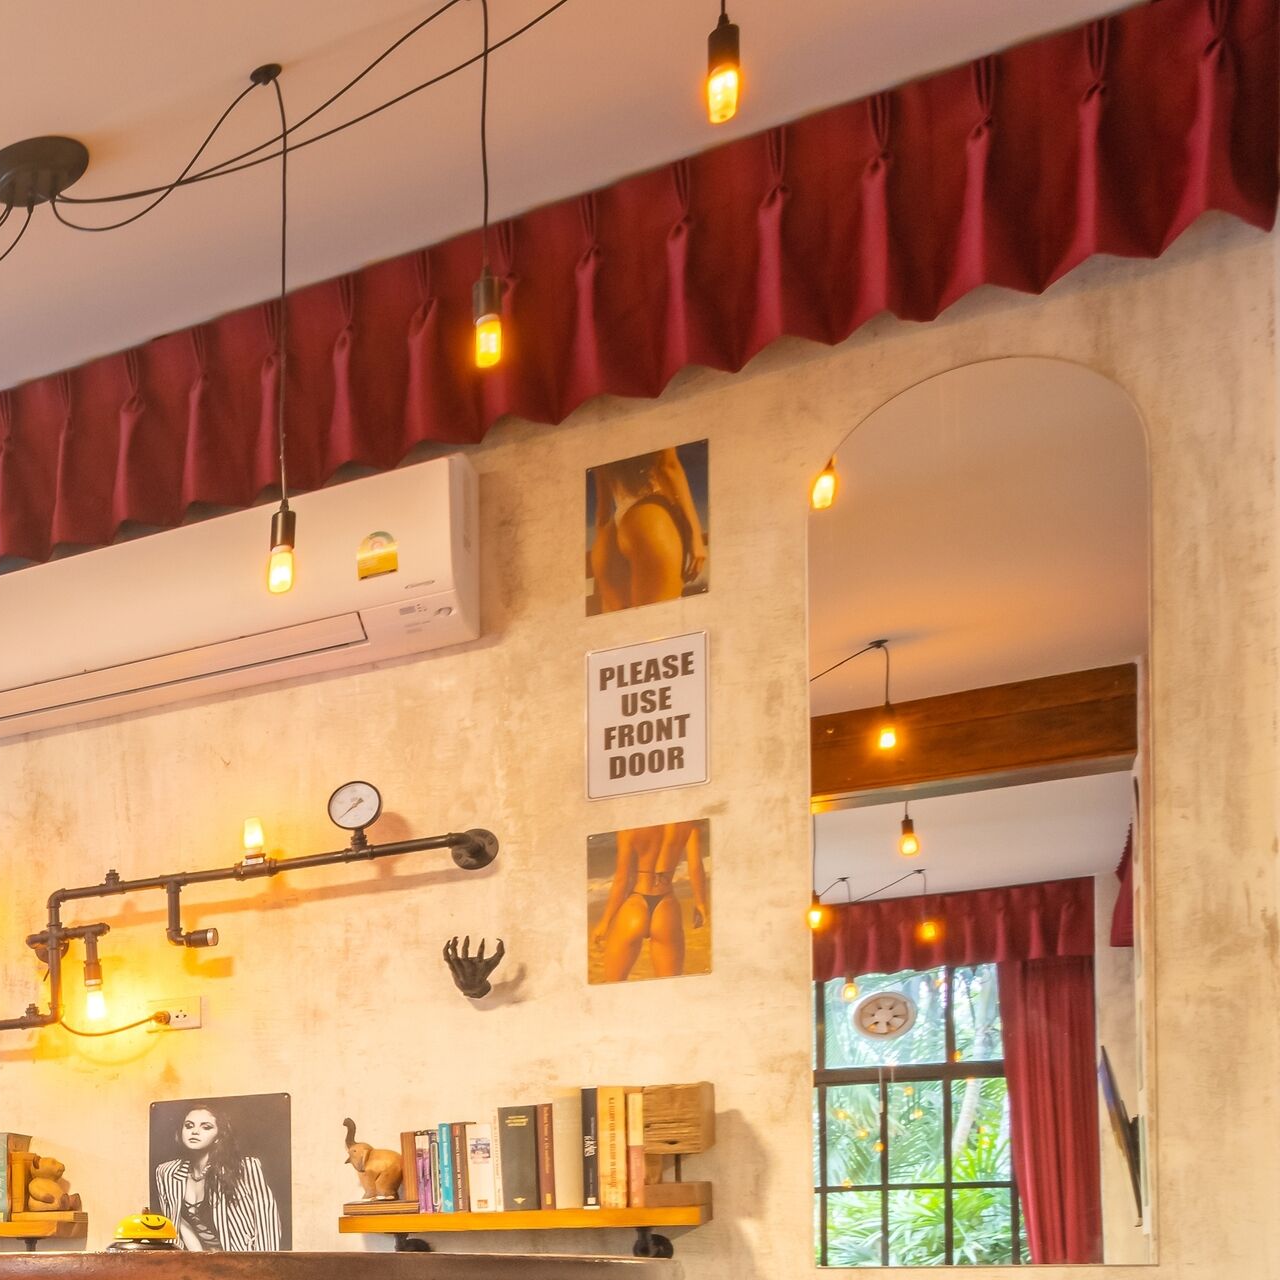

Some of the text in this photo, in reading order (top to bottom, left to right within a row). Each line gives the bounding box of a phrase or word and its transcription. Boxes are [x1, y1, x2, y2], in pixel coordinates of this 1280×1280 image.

[599, 651, 694, 691] PLEASE
[621, 686, 672, 717] USE
[604, 713, 690, 750] FRONT
[609, 746, 684, 779] DOOR
